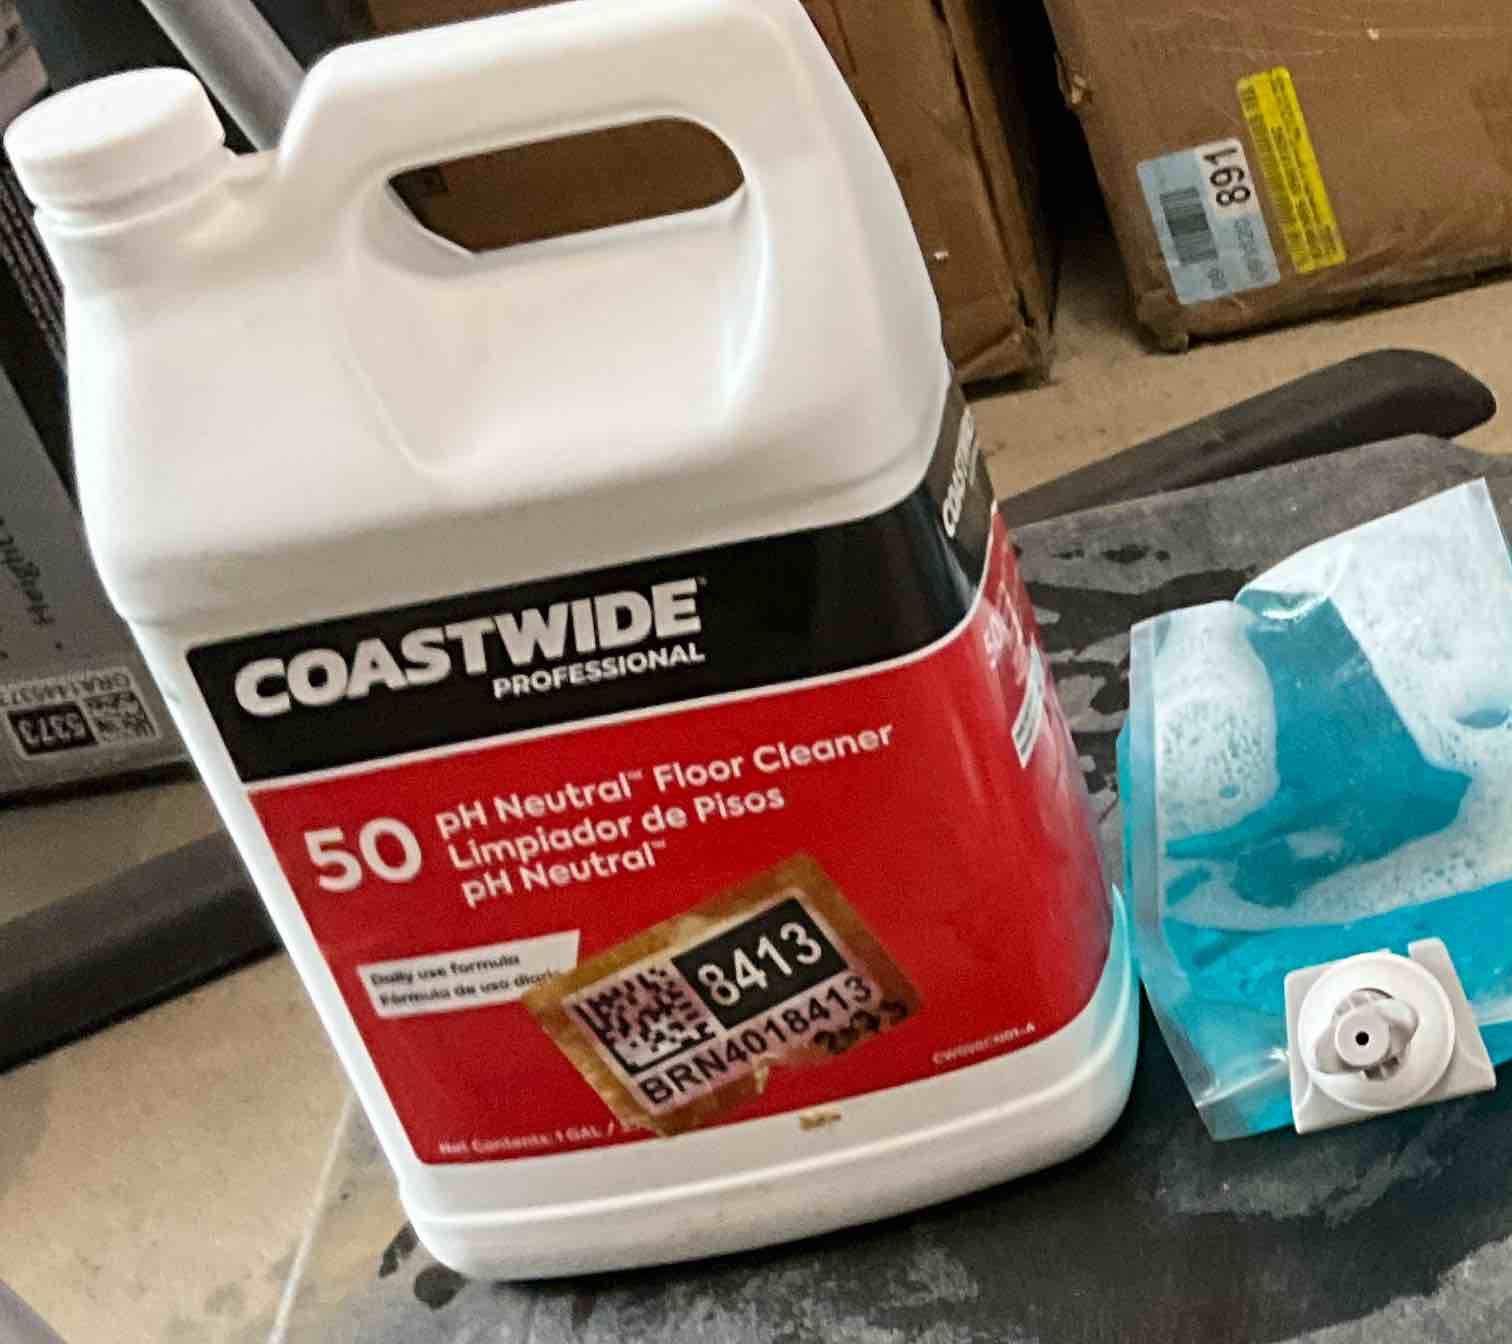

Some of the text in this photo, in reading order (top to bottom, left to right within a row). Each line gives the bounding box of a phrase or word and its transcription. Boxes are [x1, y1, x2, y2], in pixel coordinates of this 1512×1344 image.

[1202, 145, 1253, 210] 891
[237, 578, 702, 715] COASTWIDE
[495, 645, 705, 700] PROFESSIONAL
[438, 801, 492, 842] pH
[650, 758, 742, 794] Floor
[756, 725, 894, 770] Cleaner
[305, 823, 422, 889] 50
[448, 787, 785, 874] Limpiador de Pisos
[462, 868, 516, 912] pH
[371, 955, 519, 984] Daily use formula
[455, 985, 475, 996] de
[480, 981, 509, 992] uso
[698, 923, 823, 1005] 8413
[639, 975, 870, 1104] BRN4018413
[568, 1127, 600, 1140] GAL
